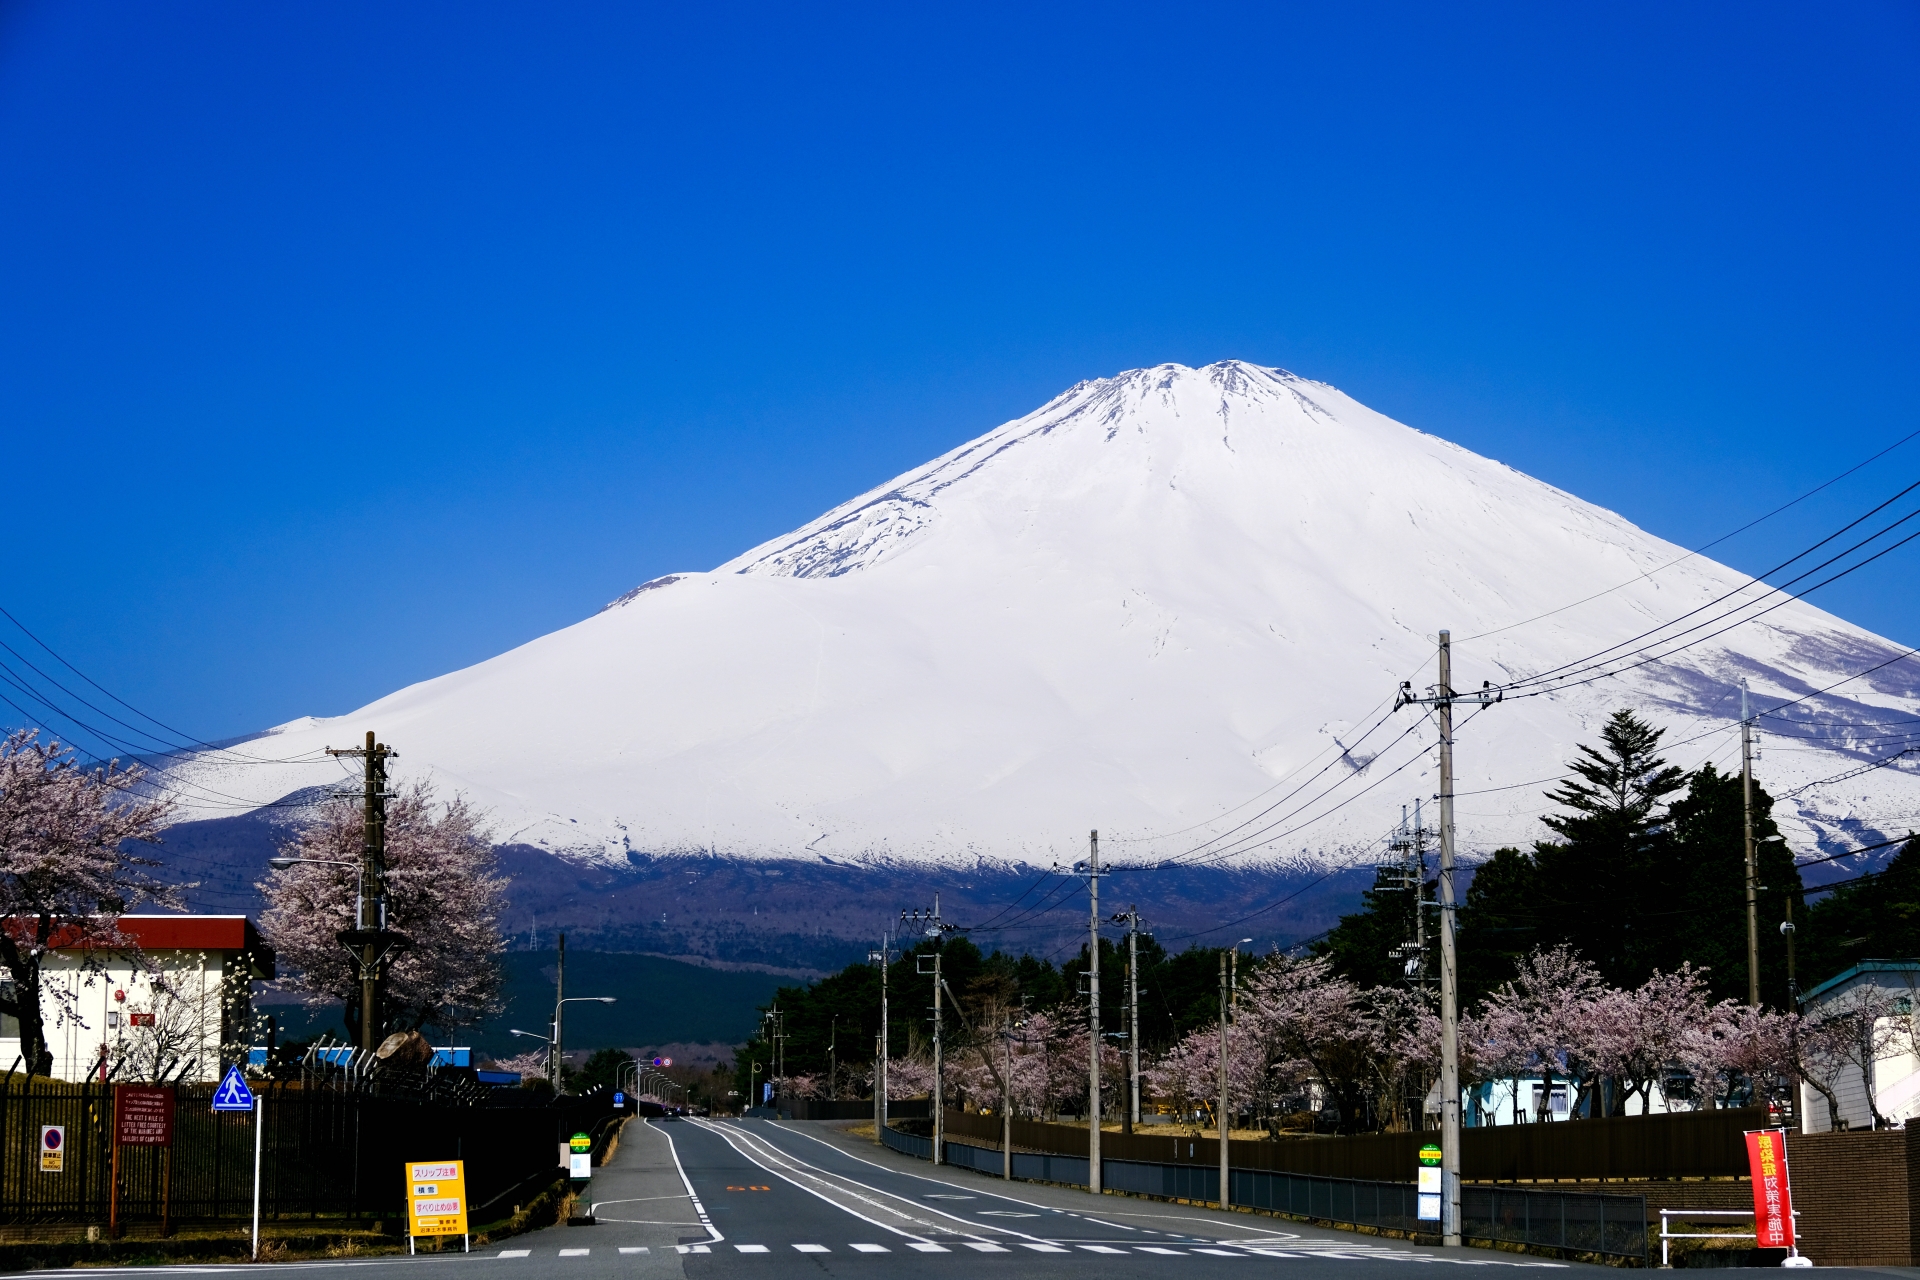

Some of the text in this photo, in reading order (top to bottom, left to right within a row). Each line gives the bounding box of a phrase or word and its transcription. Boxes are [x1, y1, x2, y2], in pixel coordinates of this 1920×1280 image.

[414, 1167, 456, 1178] スリップ注意
[416, 1202, 458, 1212] すべり止め必要
